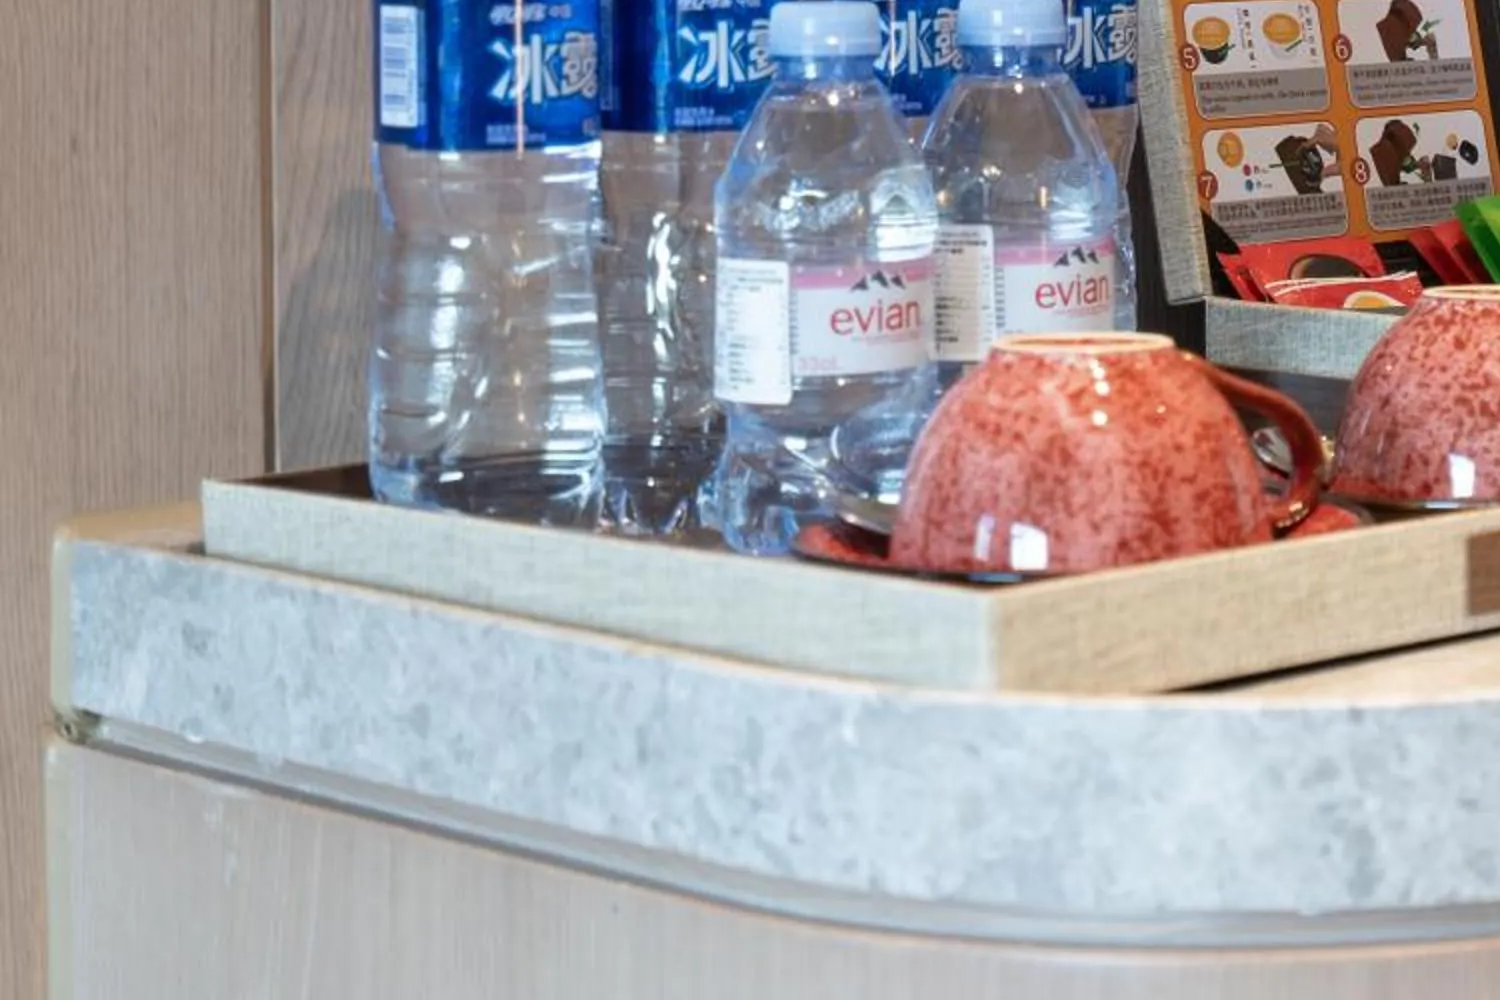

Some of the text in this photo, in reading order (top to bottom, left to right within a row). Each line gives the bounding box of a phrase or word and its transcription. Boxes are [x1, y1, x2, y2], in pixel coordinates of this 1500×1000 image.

[1183, 48, 1195, 69] 5
[1336, 39, 1348, 60] 6
[488, 32, 598, 104] 冰露
[1355, 161, 1367, 183] 8
[1201, 176, 1212, 199] 7
[1034, 273, 1109, 309] evian
[830, 300, 920, 335] evian
